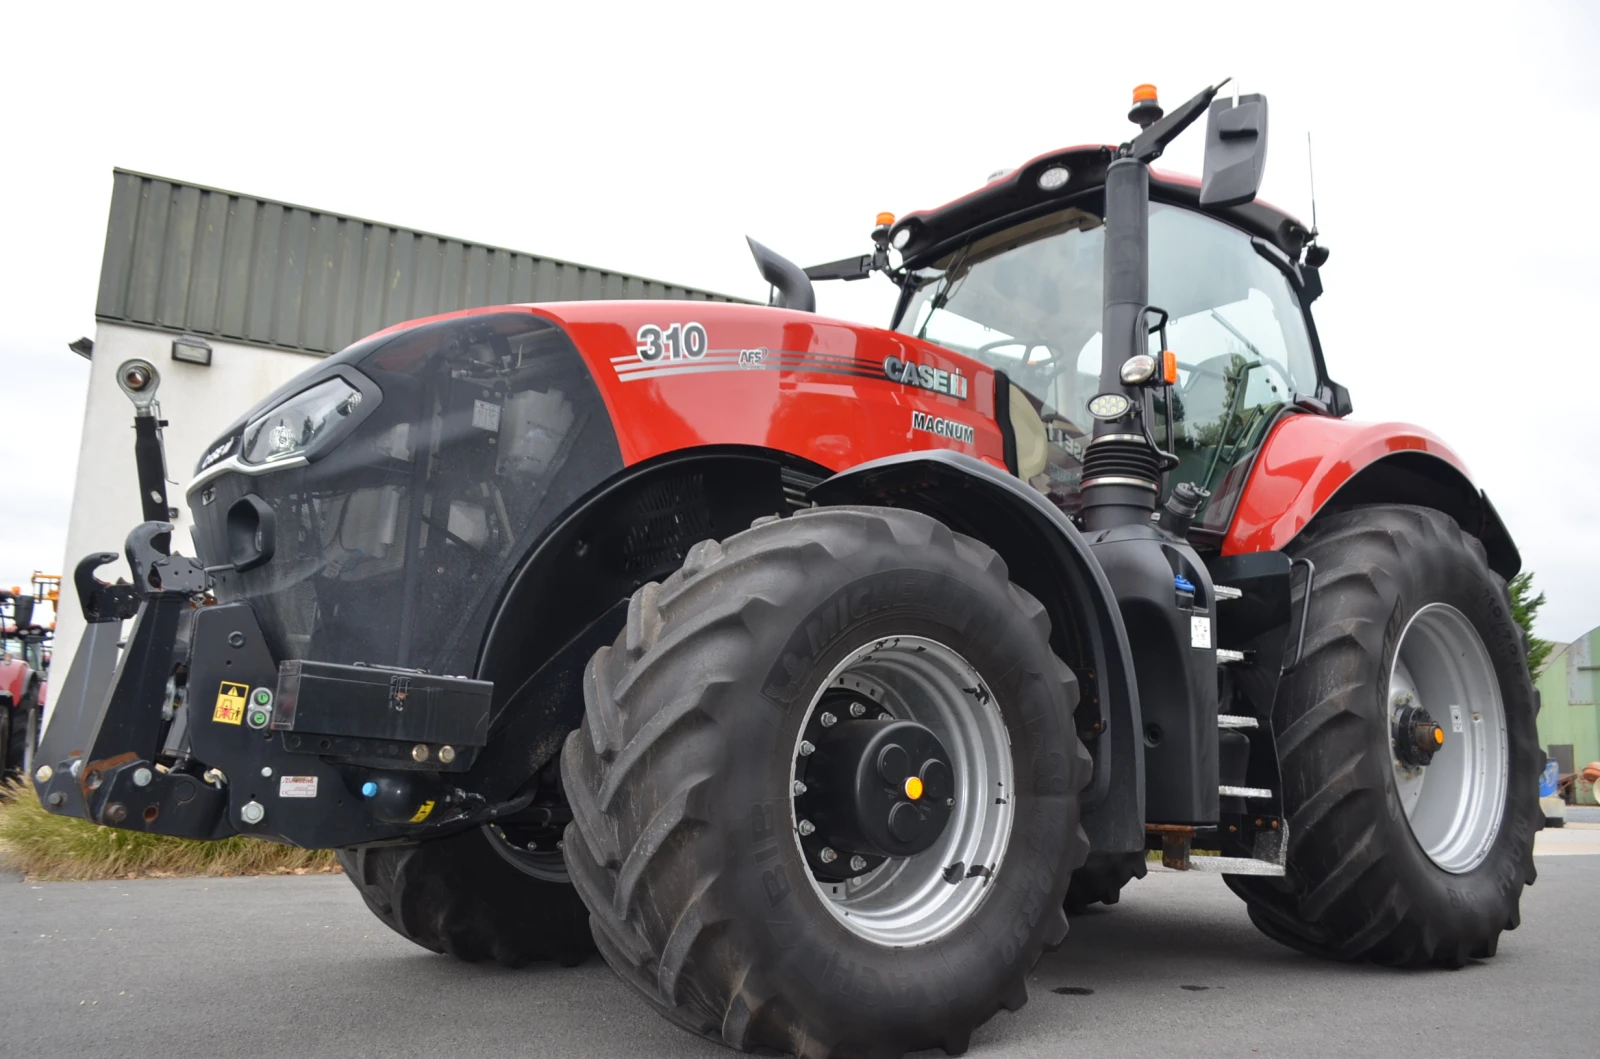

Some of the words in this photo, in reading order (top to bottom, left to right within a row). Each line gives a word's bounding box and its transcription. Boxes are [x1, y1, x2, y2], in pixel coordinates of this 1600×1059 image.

[637, 322, 708, 363] 310
[738, 349, 763, 365] AFS
[883, 355, 948, 394] CASE
[911, 410, 975, 445] MAGNUM
[750, 802, 792, 913] BIB
